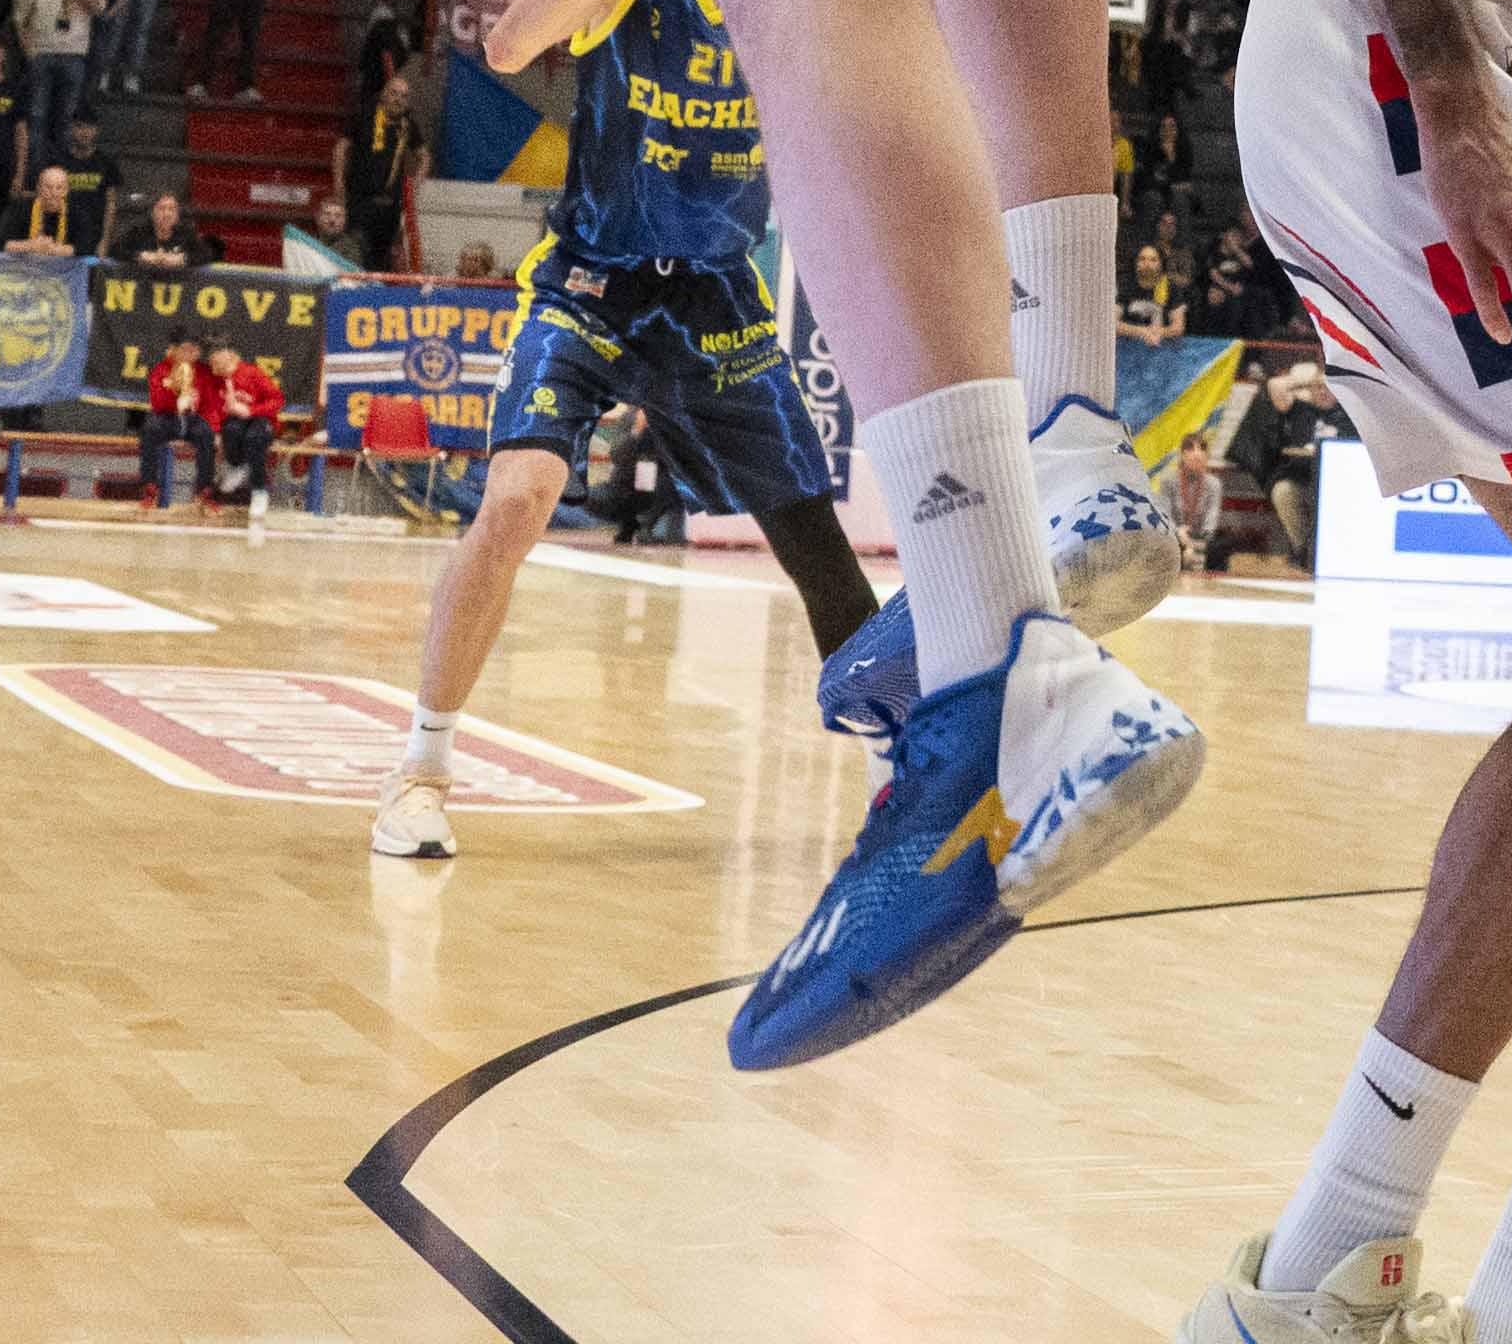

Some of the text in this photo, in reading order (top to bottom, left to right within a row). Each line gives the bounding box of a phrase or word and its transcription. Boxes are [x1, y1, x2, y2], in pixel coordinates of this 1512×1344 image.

[688, 43, 734, 88] 21
[104, 279, 317, 328] NUOVE
[345, 305, 518, 350] GRUPPO
